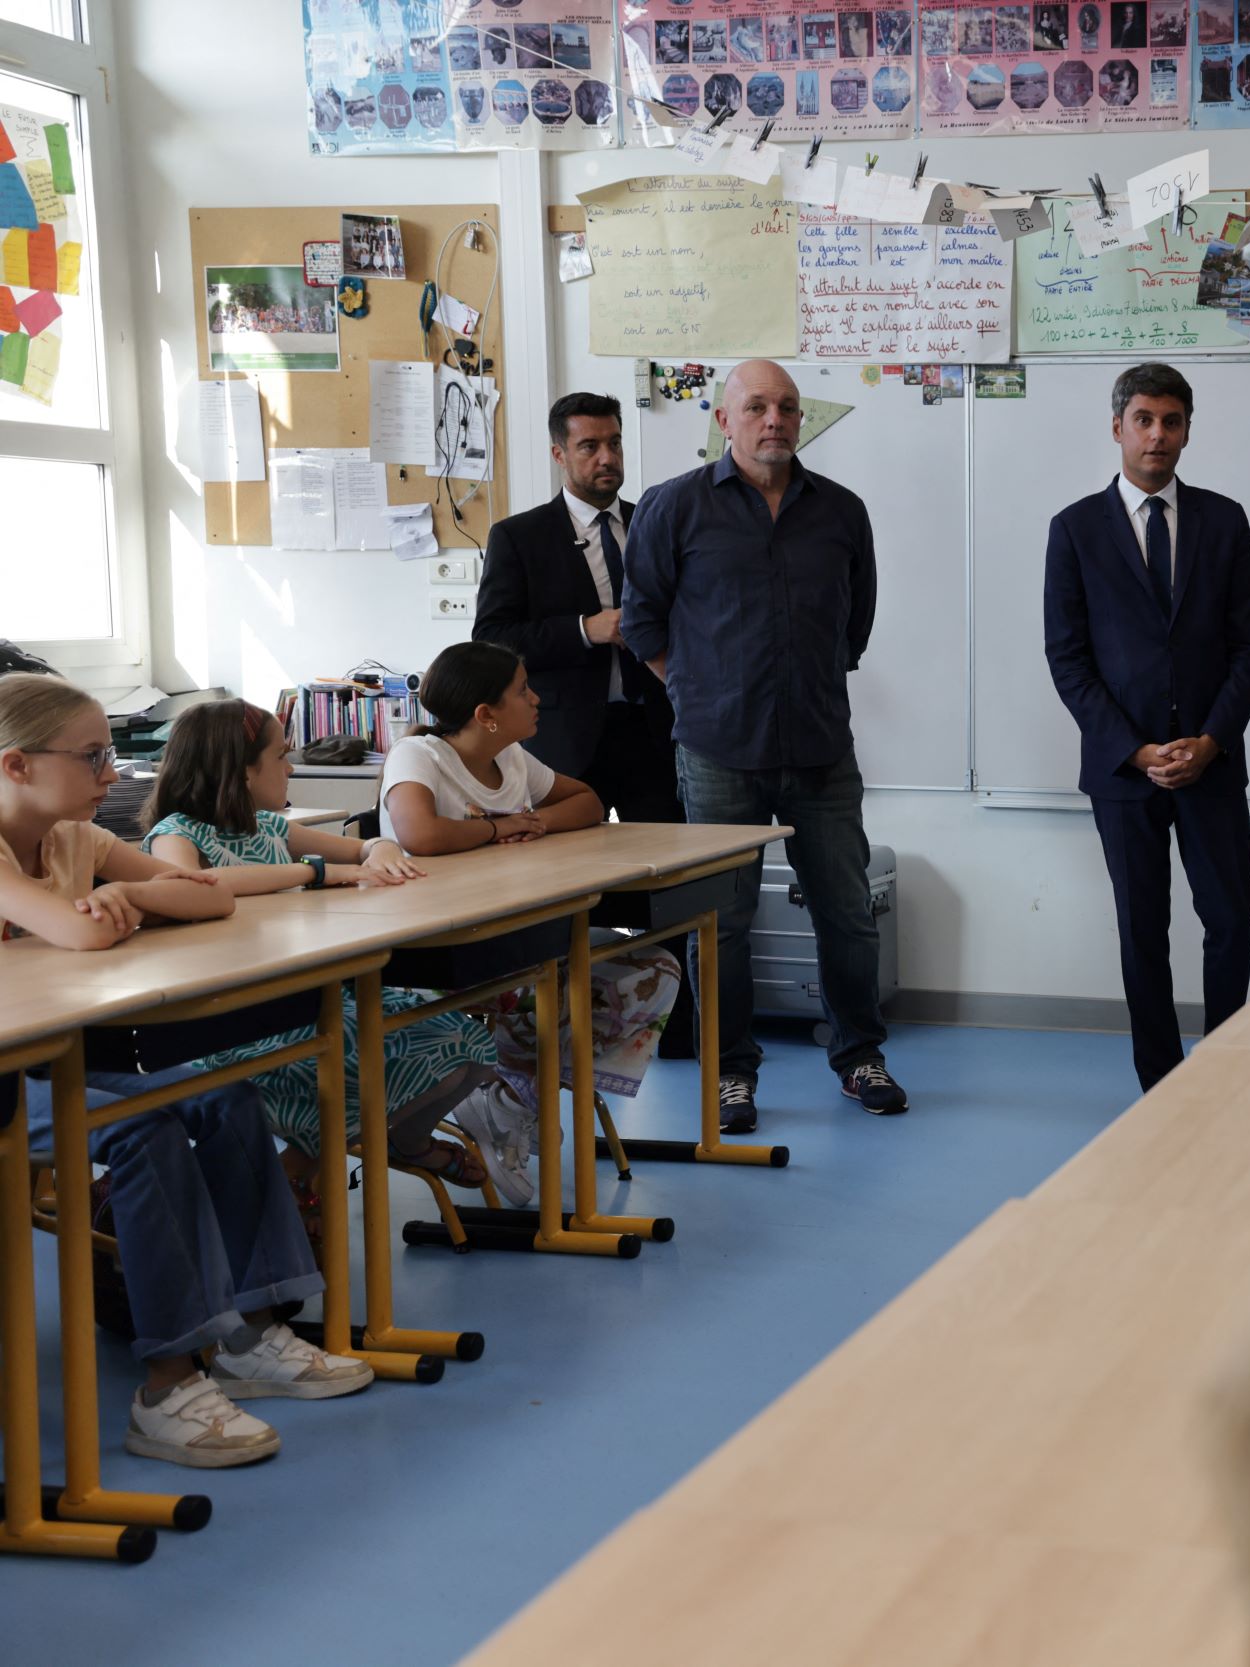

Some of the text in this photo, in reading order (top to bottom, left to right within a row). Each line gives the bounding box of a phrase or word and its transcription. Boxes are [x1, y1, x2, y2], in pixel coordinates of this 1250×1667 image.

[881, 224, 919, 237] semble
[866, 274, 885, 292] du
[890, 278, 920, 297] sujet
[986, 280, 1006, 291] en
[801, 291, 1000, 323] genre et en nombre avec son
[862, 314, 913, 340] explique
[977, 320, 1000, 339] qui
[816, 341, 872, 355] comment
[878, 341, 898, 354] est
[906, 336, 919, 352] le
